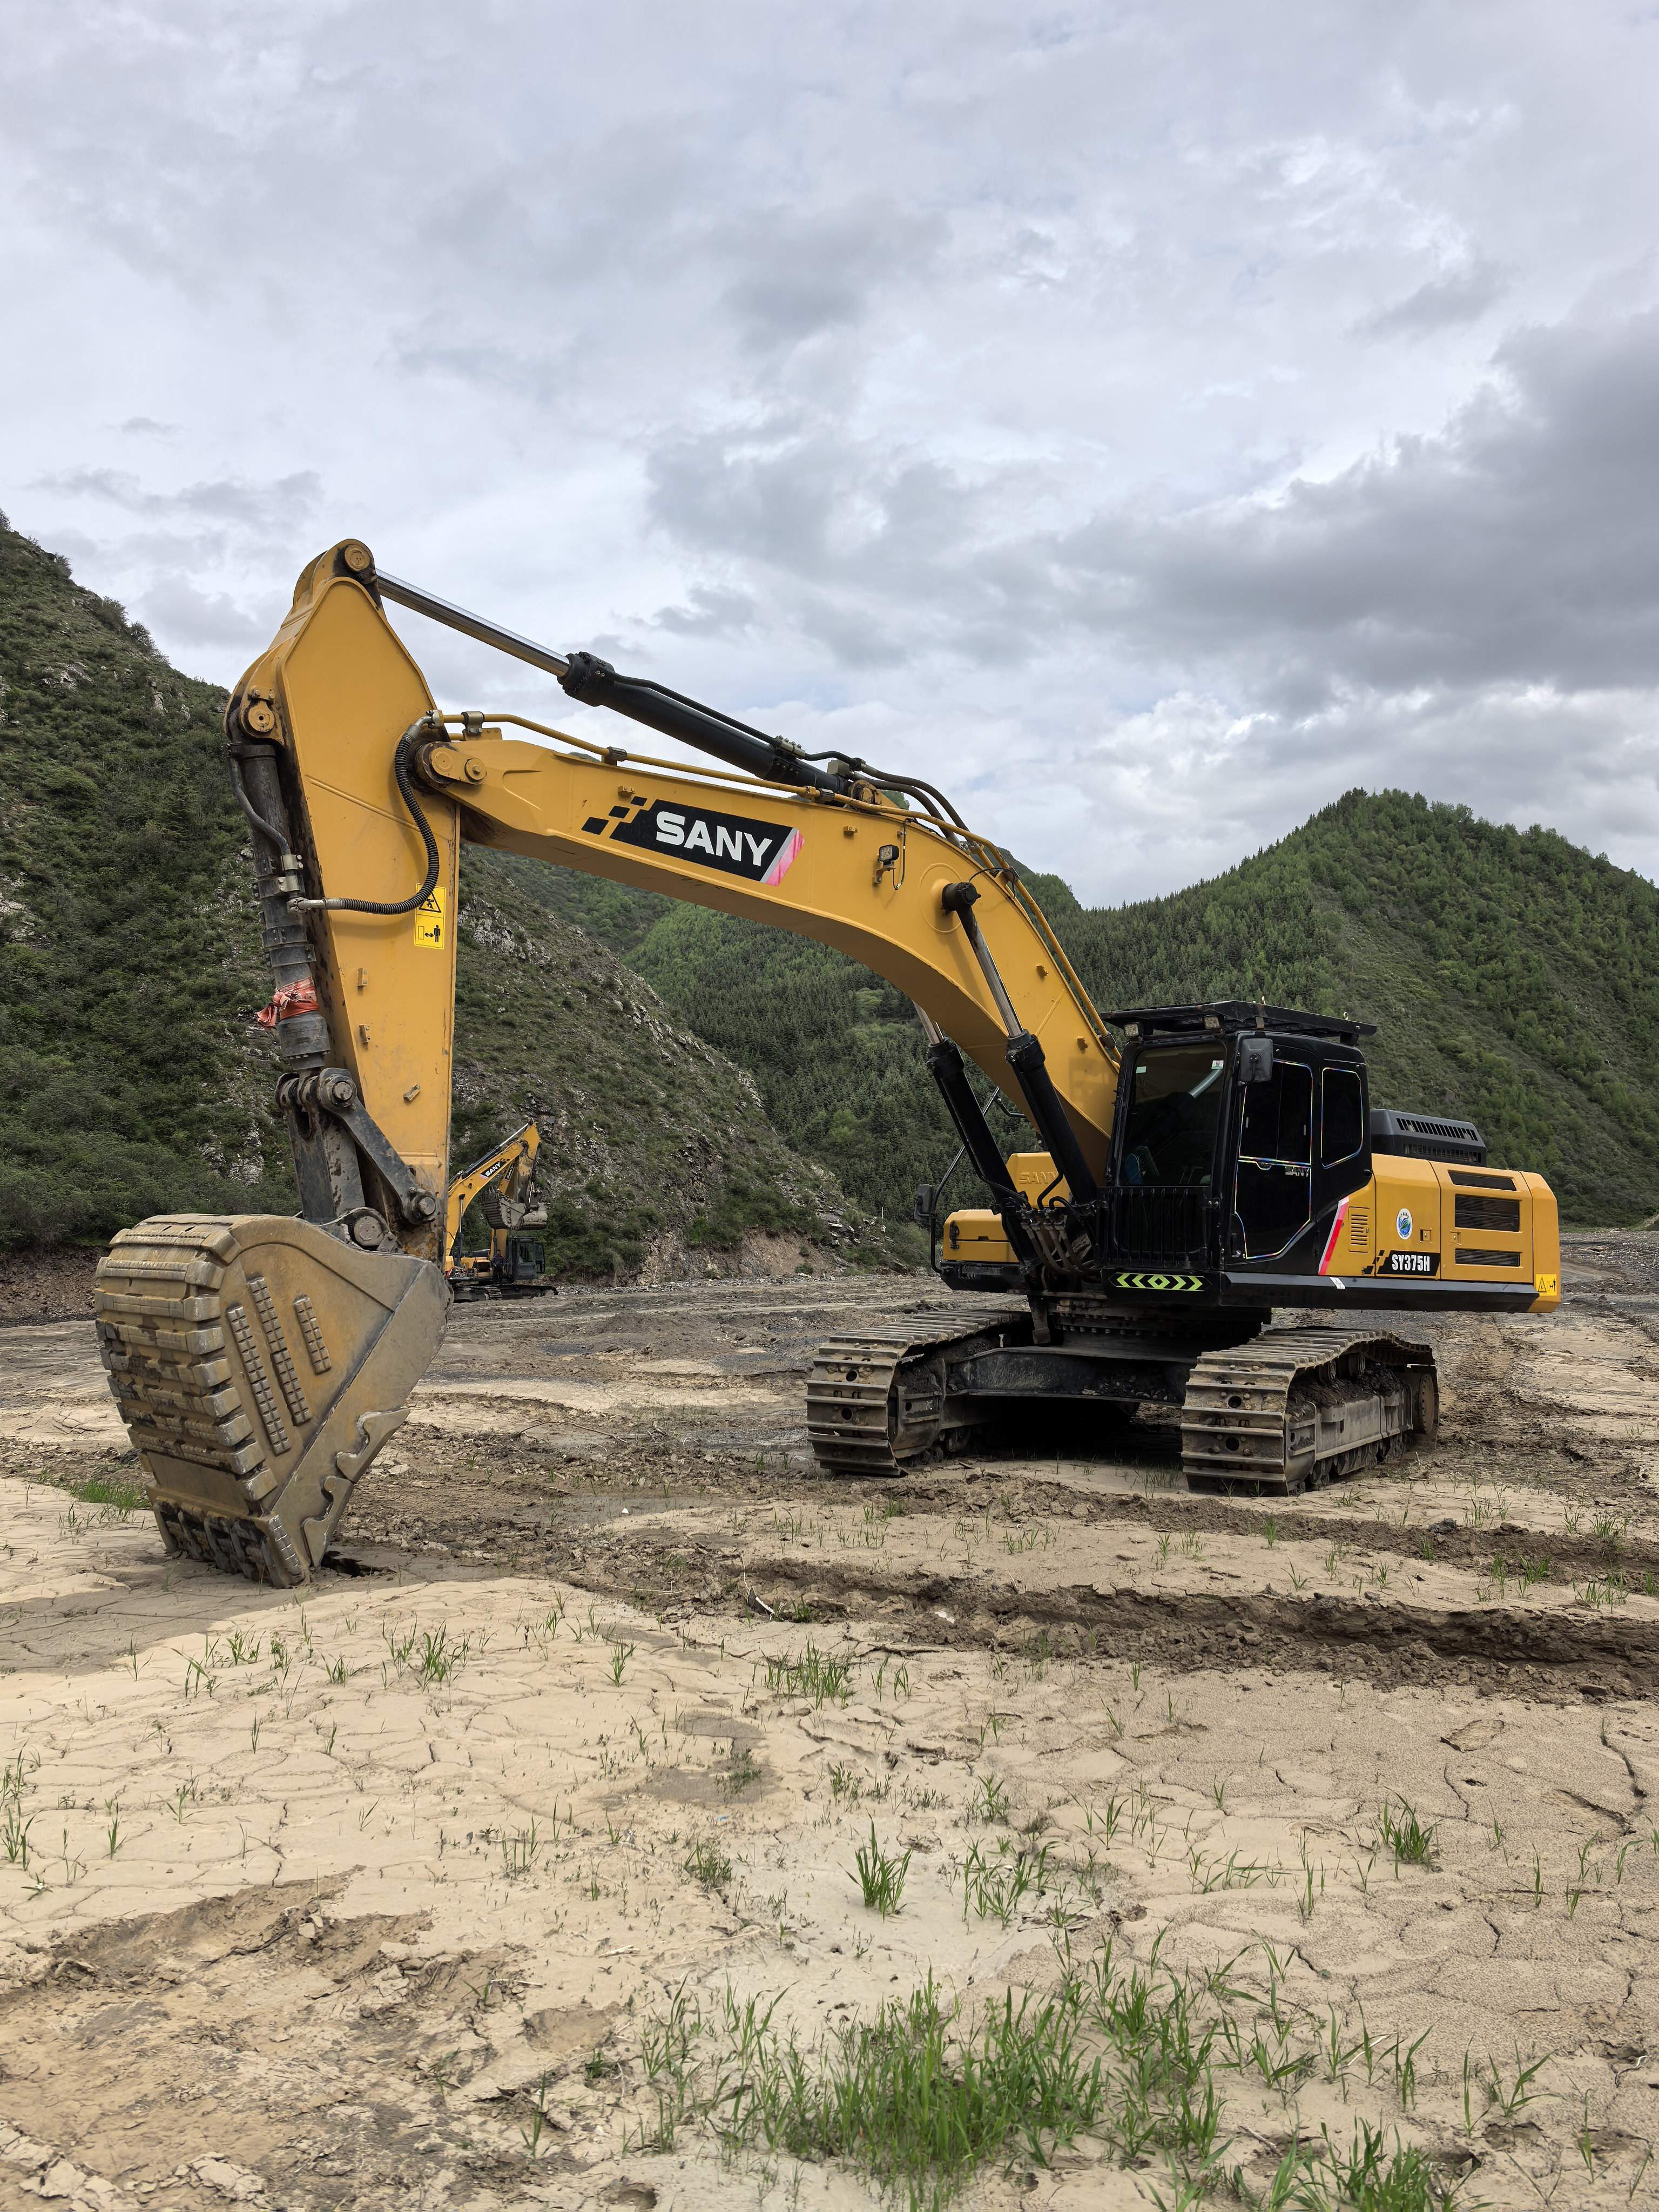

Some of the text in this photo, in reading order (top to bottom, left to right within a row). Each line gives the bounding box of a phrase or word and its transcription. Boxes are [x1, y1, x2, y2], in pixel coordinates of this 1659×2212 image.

[656, 811, 772, 866] SANY
[485, 1162, 501, 1177] SANY
[1285, 1166, 1310, 1177] SANY
[1392, 1254, 1430, 1272] SY375H
